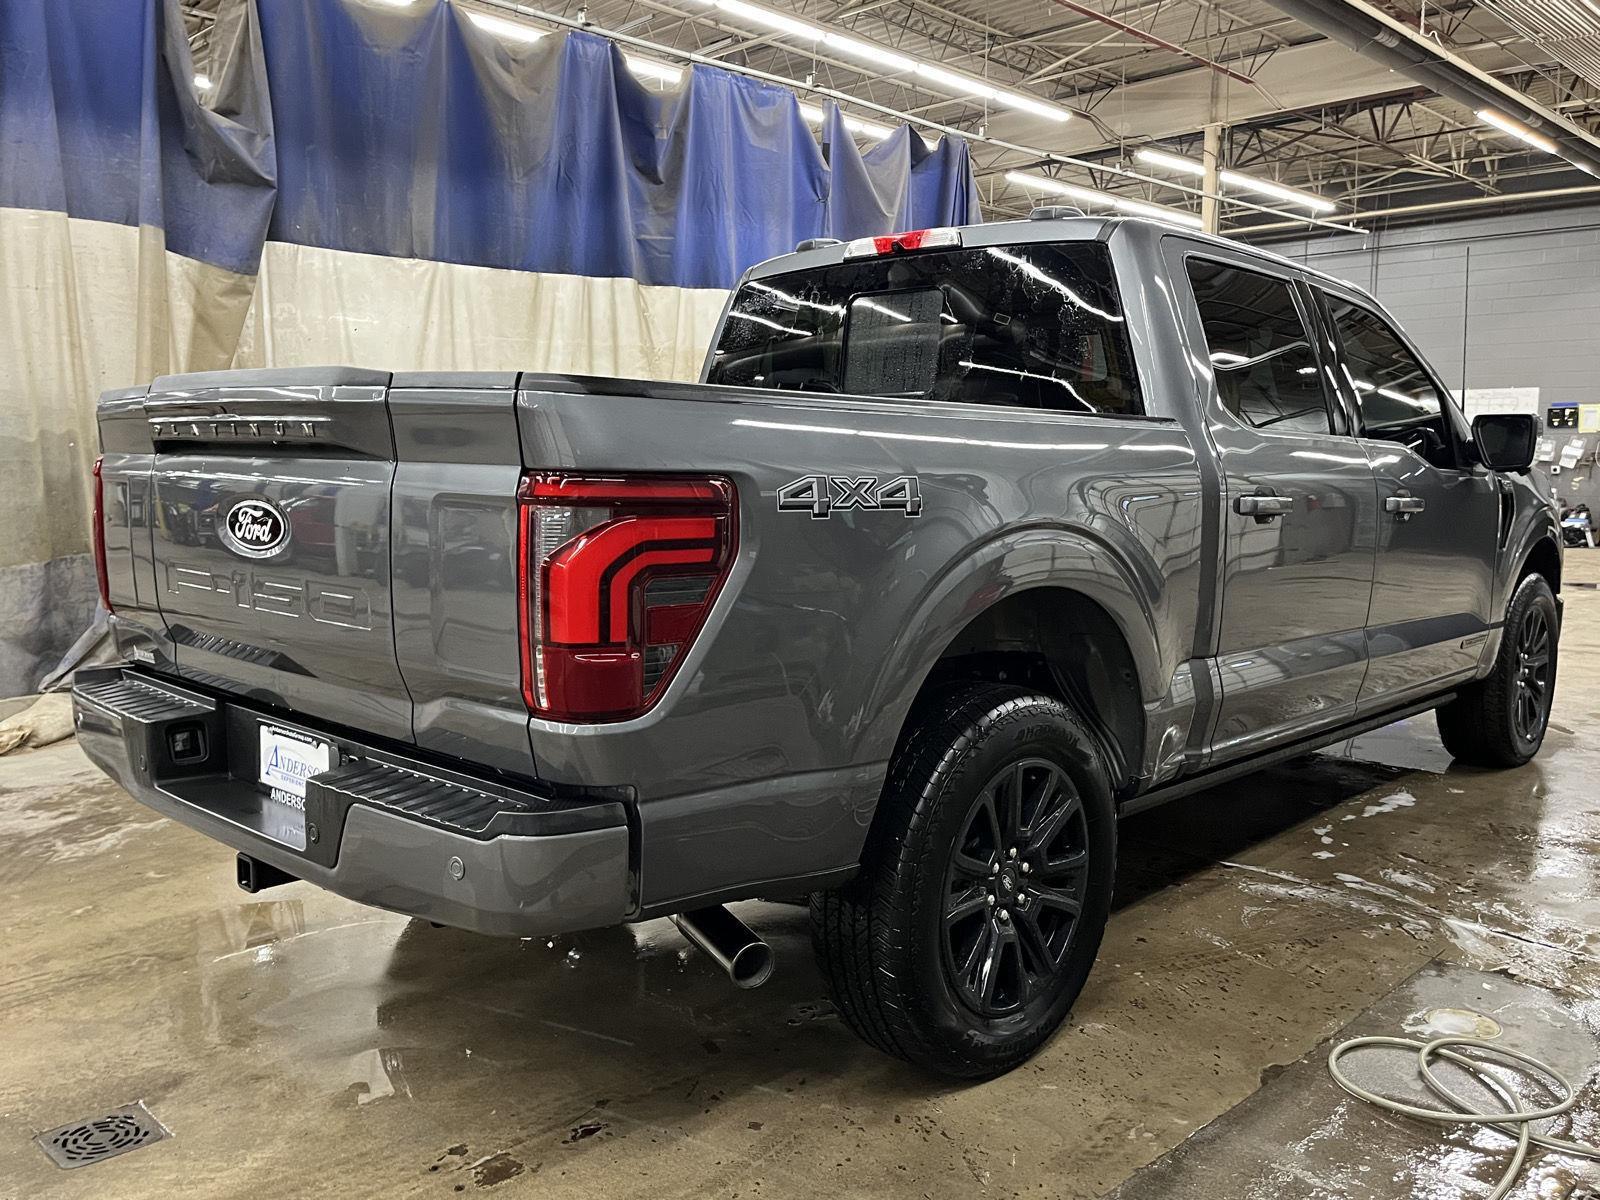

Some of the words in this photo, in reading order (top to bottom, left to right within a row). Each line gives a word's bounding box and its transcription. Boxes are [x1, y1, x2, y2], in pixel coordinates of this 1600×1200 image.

[153, 423, 316, 438] PLATINUM
[235, 507, 273, 542] Ford
[164, 562, 373, 631] F-150
[265, 745, 323, 777] ANDERSO
